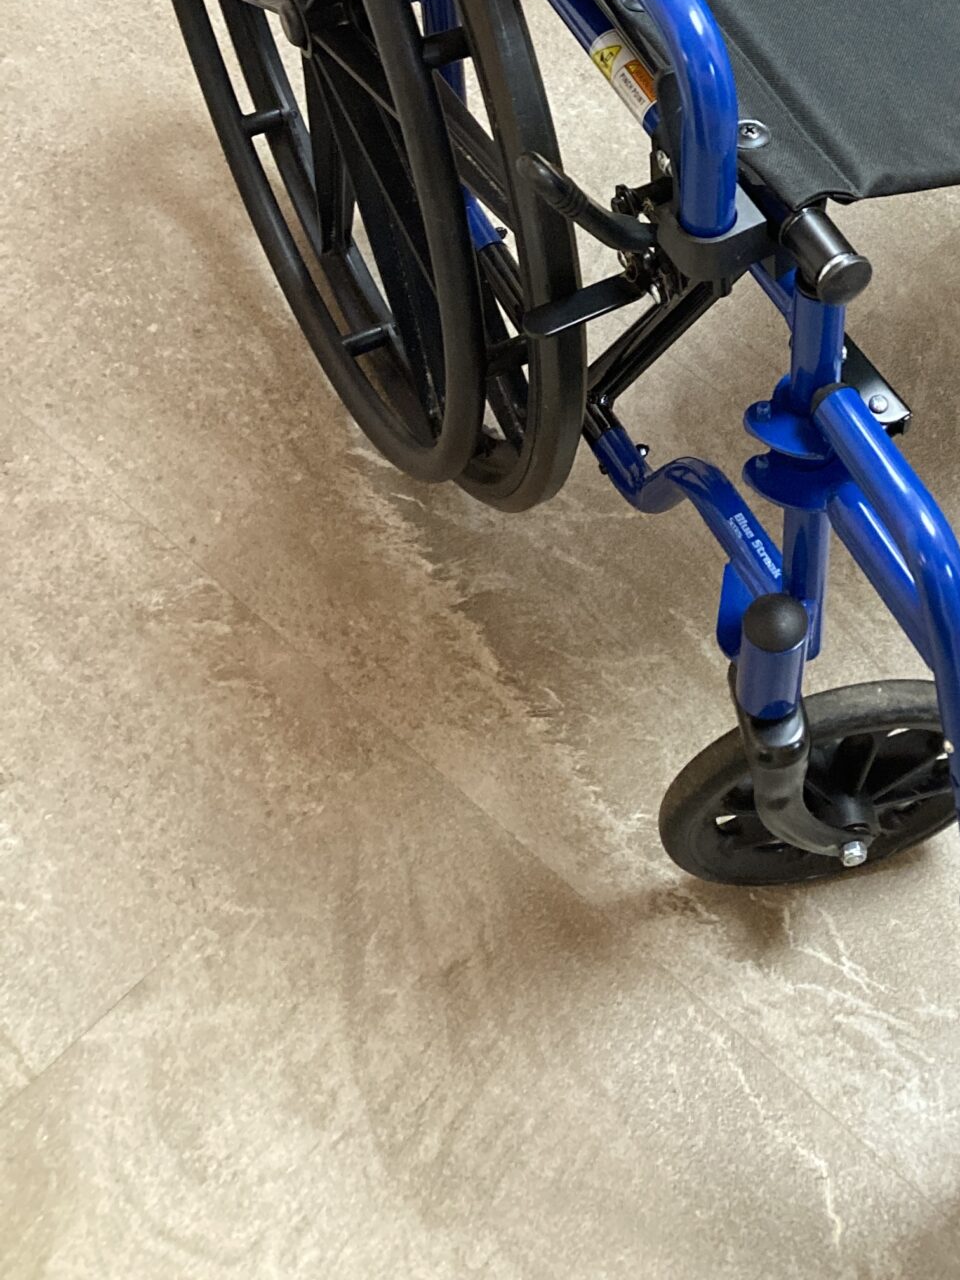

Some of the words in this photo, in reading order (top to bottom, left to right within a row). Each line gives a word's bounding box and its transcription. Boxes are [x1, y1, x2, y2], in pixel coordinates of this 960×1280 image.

[619, 72, 634, 90] PINCH
[630, 87, 646, 105] POINT
[734, 512, 755, 539] Blue
[751, 539, 782, 579] Streak
